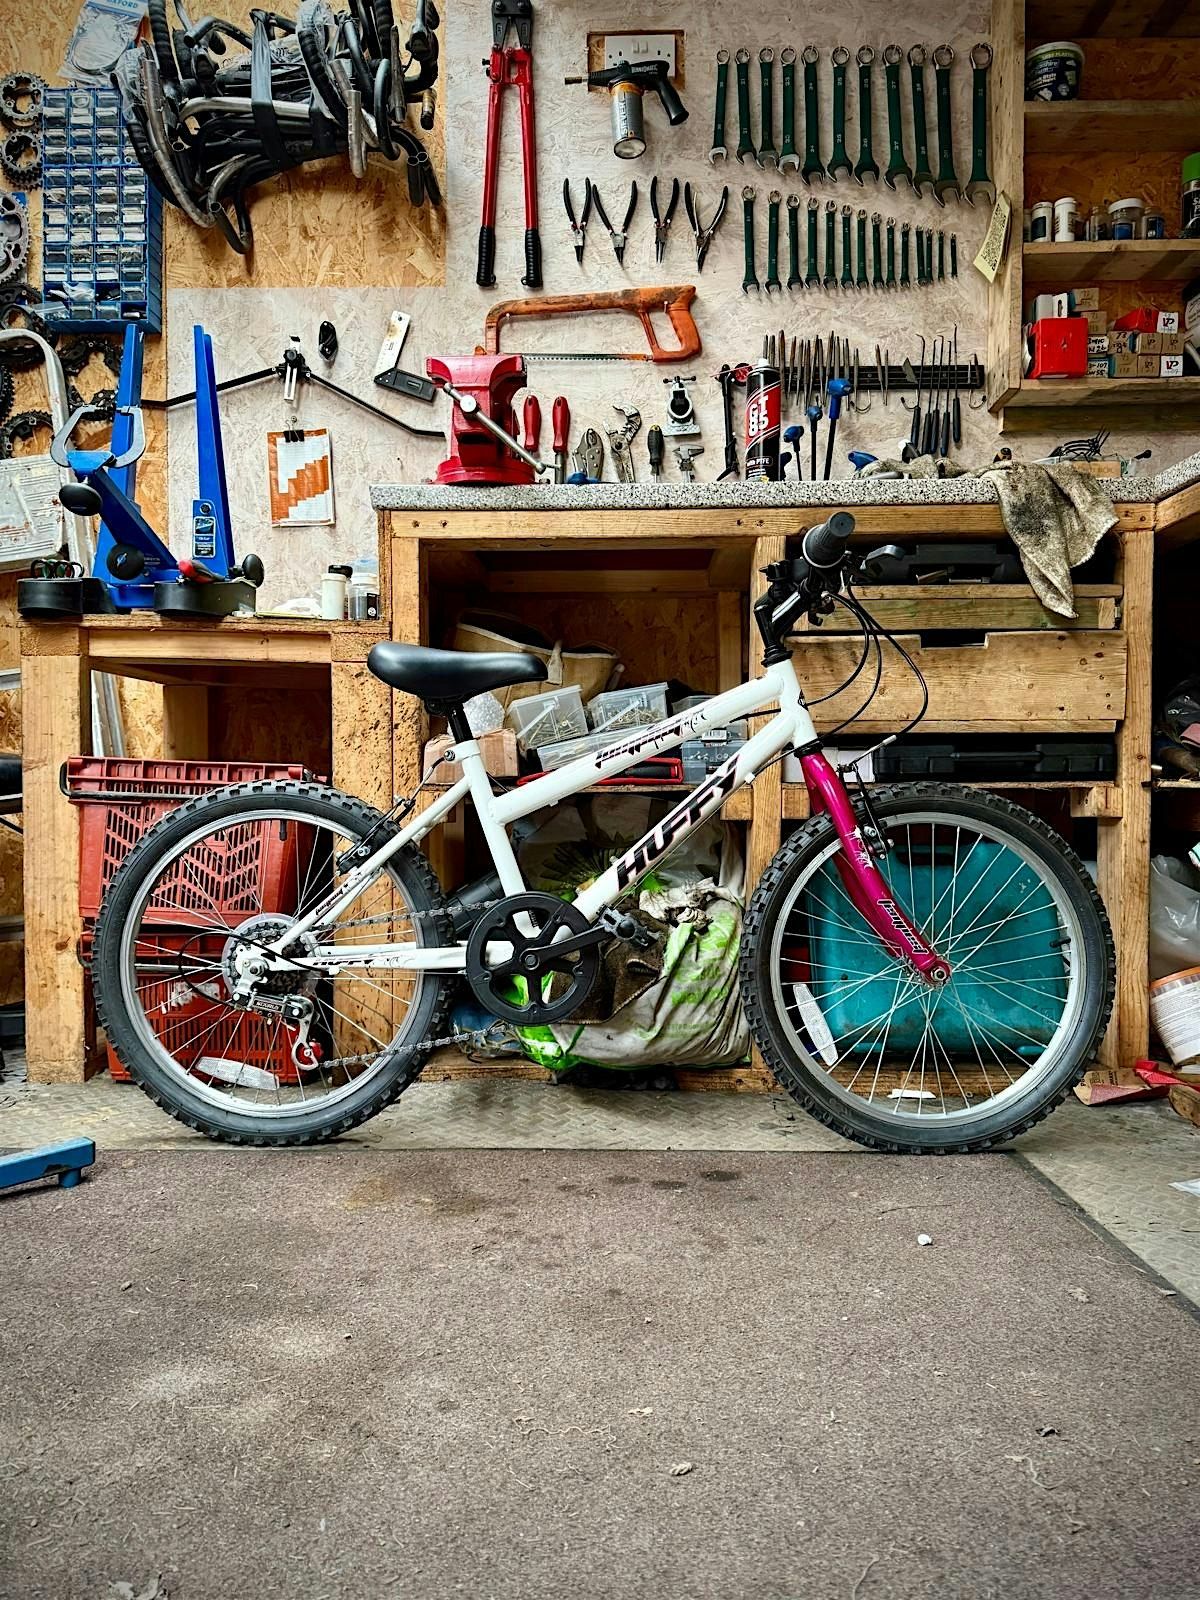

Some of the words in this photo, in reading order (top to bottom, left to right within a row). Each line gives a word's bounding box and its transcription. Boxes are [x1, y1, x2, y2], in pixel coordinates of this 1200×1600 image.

[749, 394, 769, 418] GT
[749, 410, 769, 437] 85
[756, 457, 770, 465] PTFE
[617, 754, 740, 891] HUFFY
